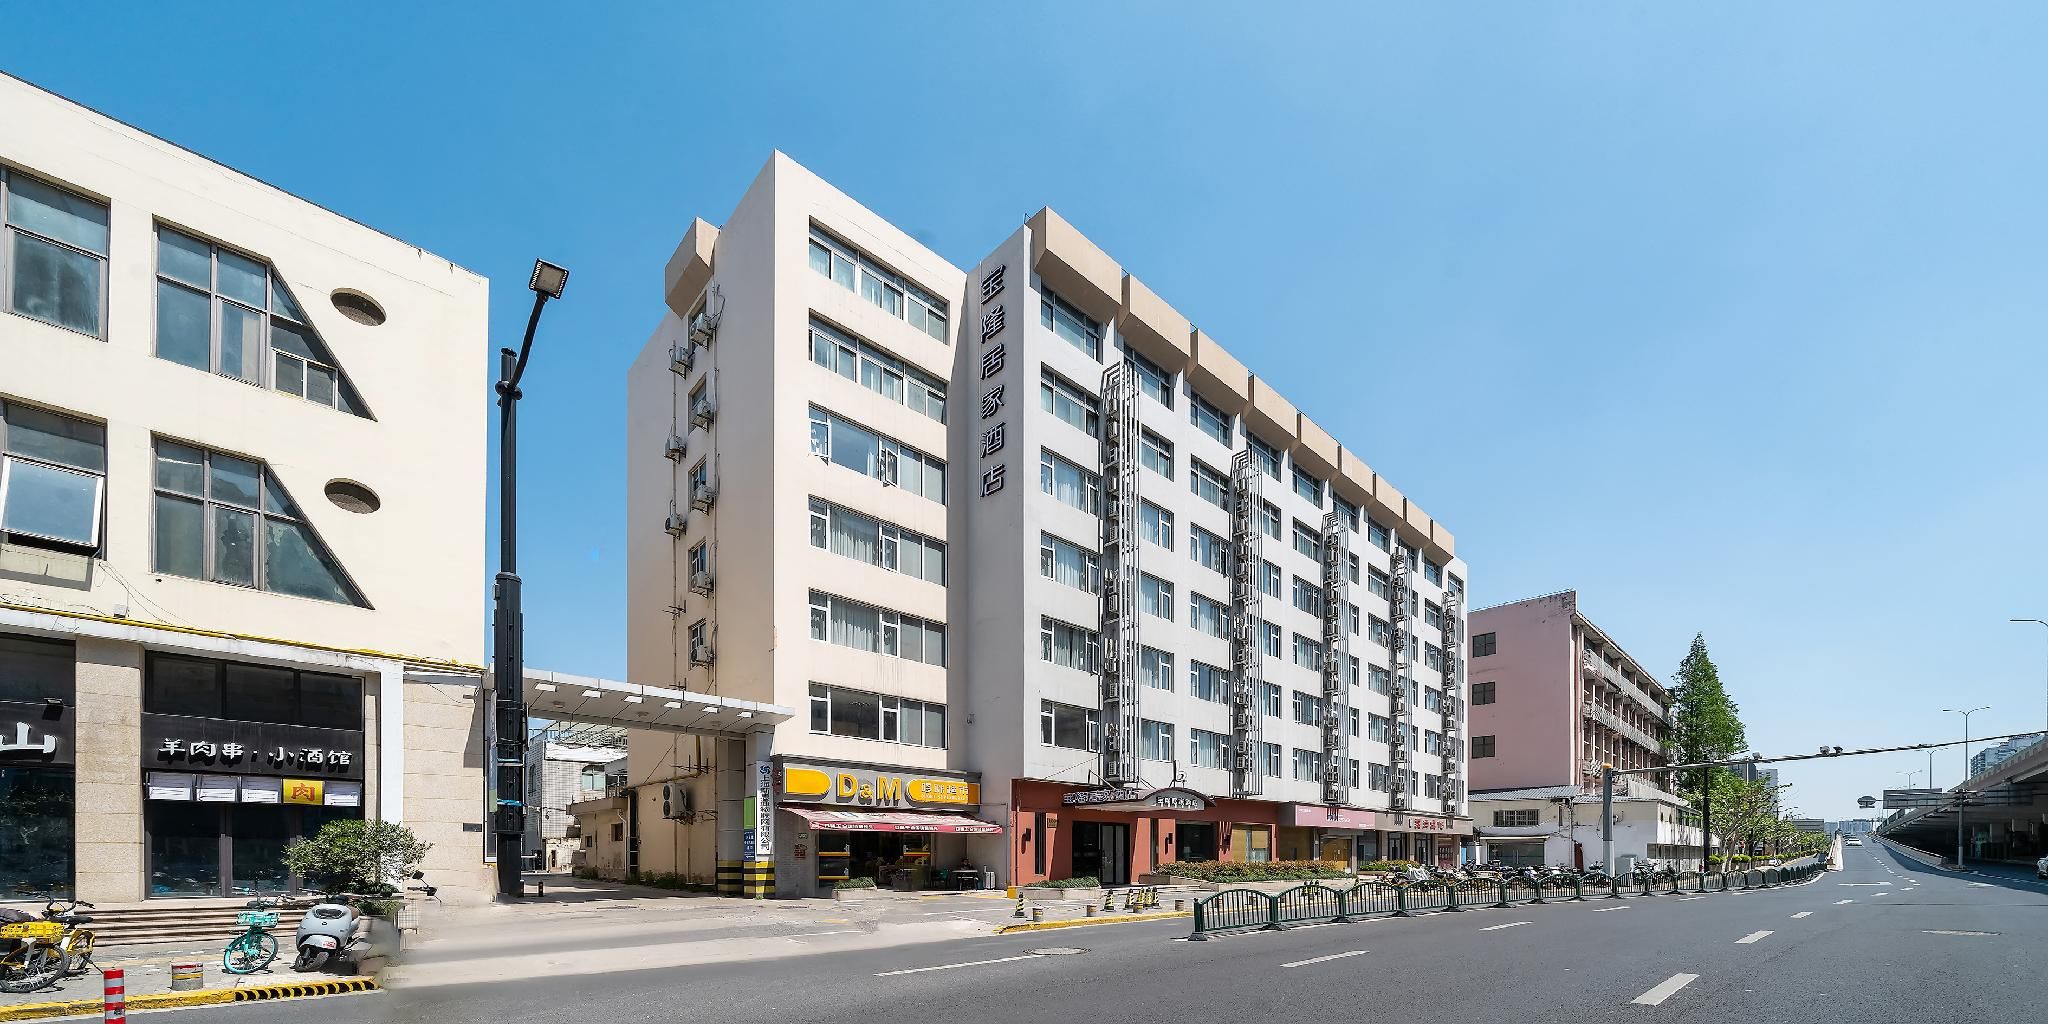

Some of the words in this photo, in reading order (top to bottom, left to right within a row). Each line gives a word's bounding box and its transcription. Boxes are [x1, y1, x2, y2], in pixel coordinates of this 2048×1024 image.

[980, 264, 1006, 498] 宝隆居家酒店
[0, 721, 57, 754] 山
[291, 783, 316, 801] 肉
[836, 773, 902, 800] D&M
